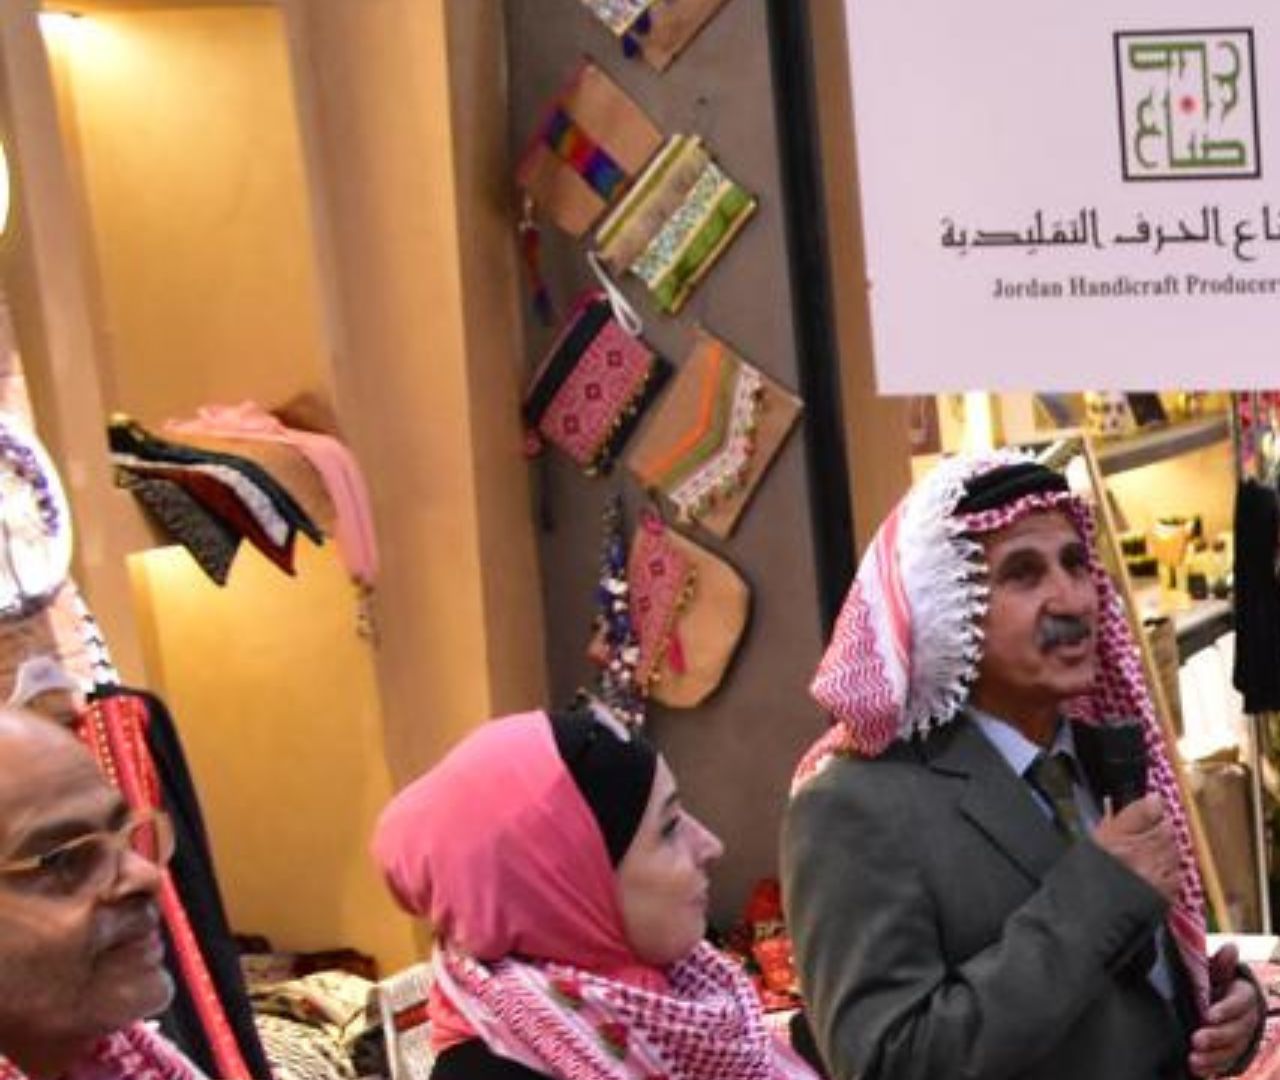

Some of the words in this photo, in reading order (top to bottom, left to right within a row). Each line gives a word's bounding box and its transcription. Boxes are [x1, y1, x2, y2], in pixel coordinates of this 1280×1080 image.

[941, 207, 1105, 256] التقليدية
[1113, 206, 1226, 255] الحرف
[993, 278, 1063, 298] Jordan
[1070, 275, 1179, 296] Handicraft
